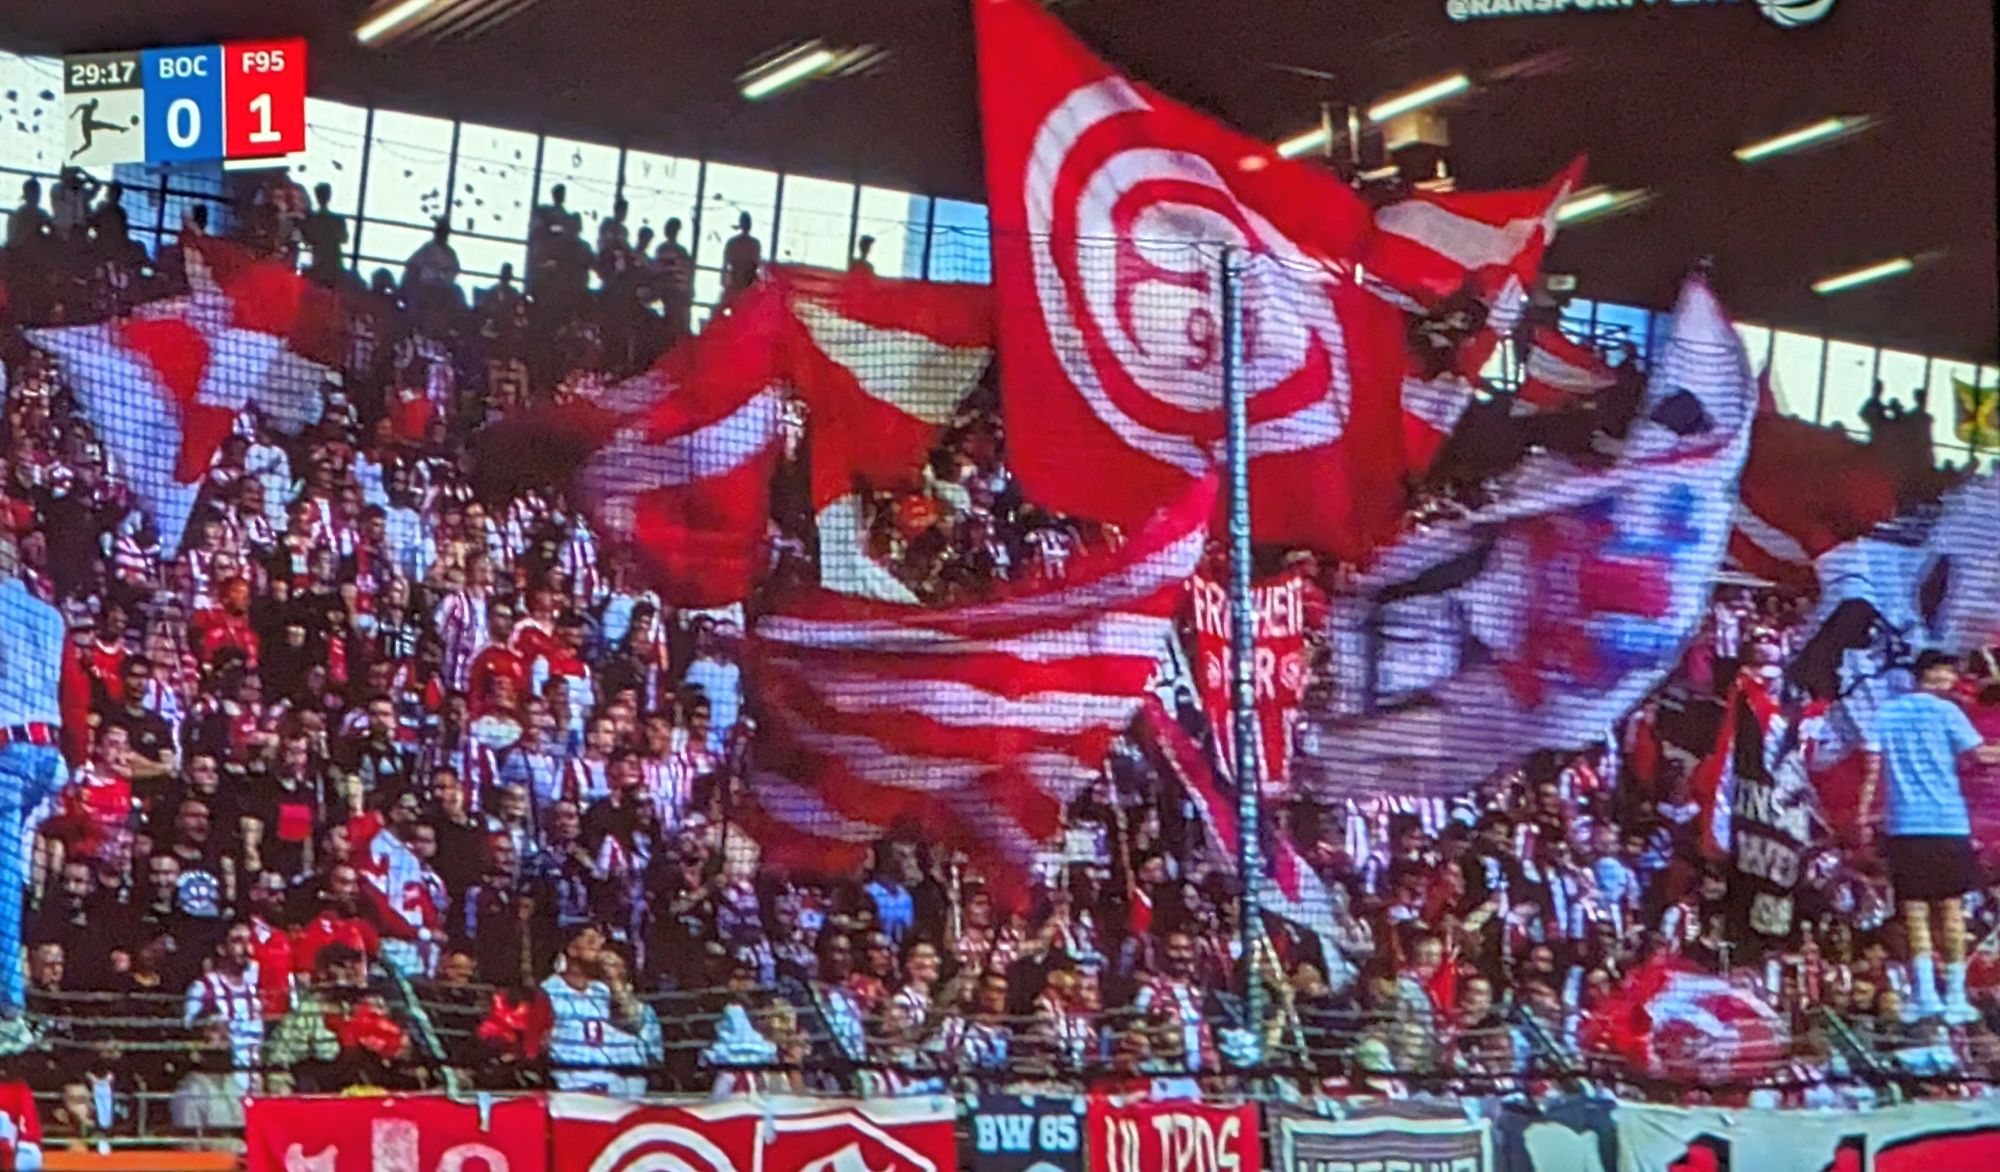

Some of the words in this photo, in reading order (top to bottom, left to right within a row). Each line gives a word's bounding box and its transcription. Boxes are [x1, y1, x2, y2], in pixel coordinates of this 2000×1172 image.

[71, 61, 135, 85] 29:17
[159, 55, 208, 78] BOC
[242, 50, 285, 73] F95
[166, 98, 201, 148] 0
[249, 93, 282, 143] 1
[1193, 574, 1304, 640] FRHEIT
[975, 1114, 1033, 1150] BW
[1038, 1114, 1077, 1149] 85
